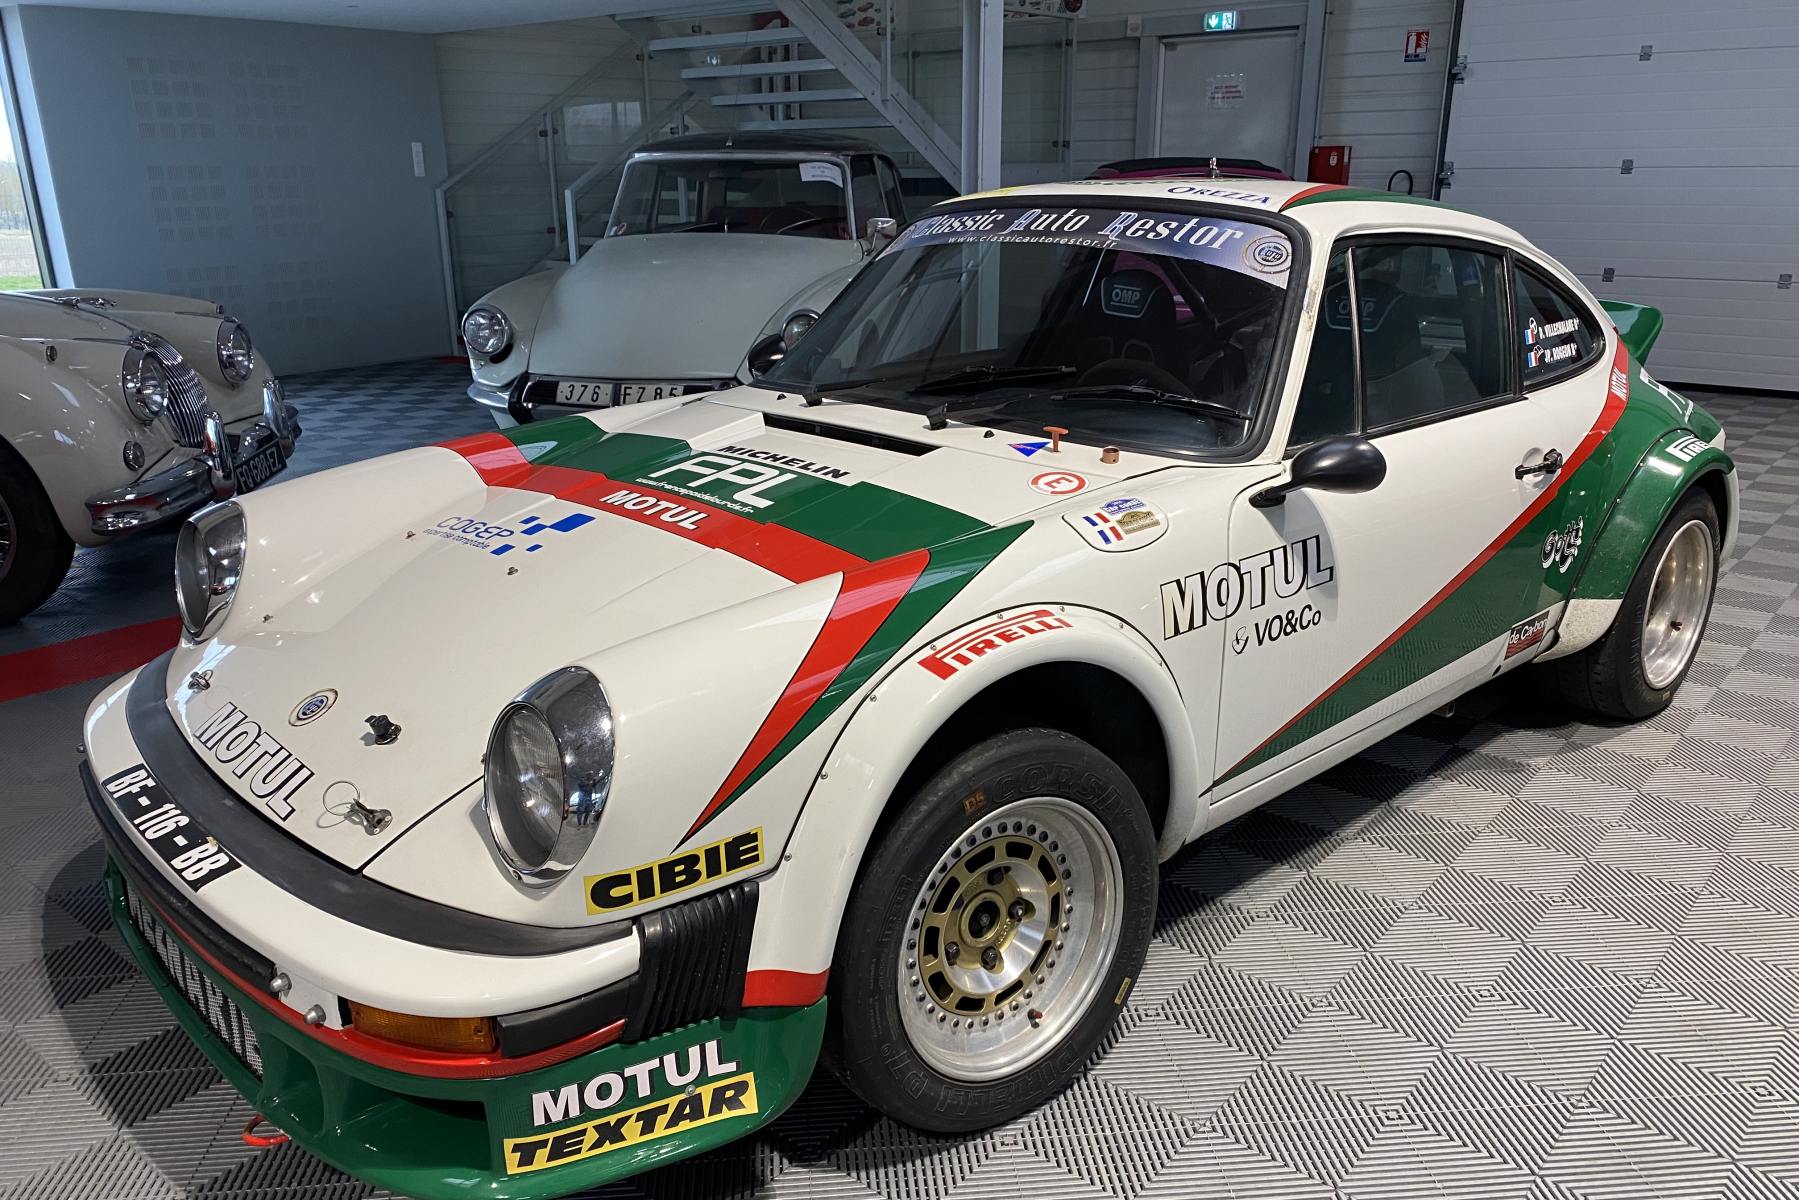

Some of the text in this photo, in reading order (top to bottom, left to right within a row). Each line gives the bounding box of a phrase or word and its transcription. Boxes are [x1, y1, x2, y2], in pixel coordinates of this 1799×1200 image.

[1167, 186, 1270, 205] OREZZA
[911, 208, 1004, 238] Classic
[998, 208, 1090, 234] Auto
[1097, 210, 1243, 250] Restor
[949, 234, 1118, 249] www.classicautorestor.fr
[1111, 288, 1141, 305] OMP
[564, 383, 601, 403] 376
[648, 455, 798, 509] FPL
[717, 445, 852, 479] MICHELIN
[436, 516, 515, 541] COGEP
[599, 490, 711, 532] MOTUL
[1159, 534, 1335, 641] MOTUL
[917, 608, 1075, 681] PIRELLI
[1254, 604, 1322, 647] VO&Co
[194, 701, 316, 822] MOTUL
[532, 1038, 741, 1128] MOTUL
[509, 1079, 751, 1169] TEXTAR
